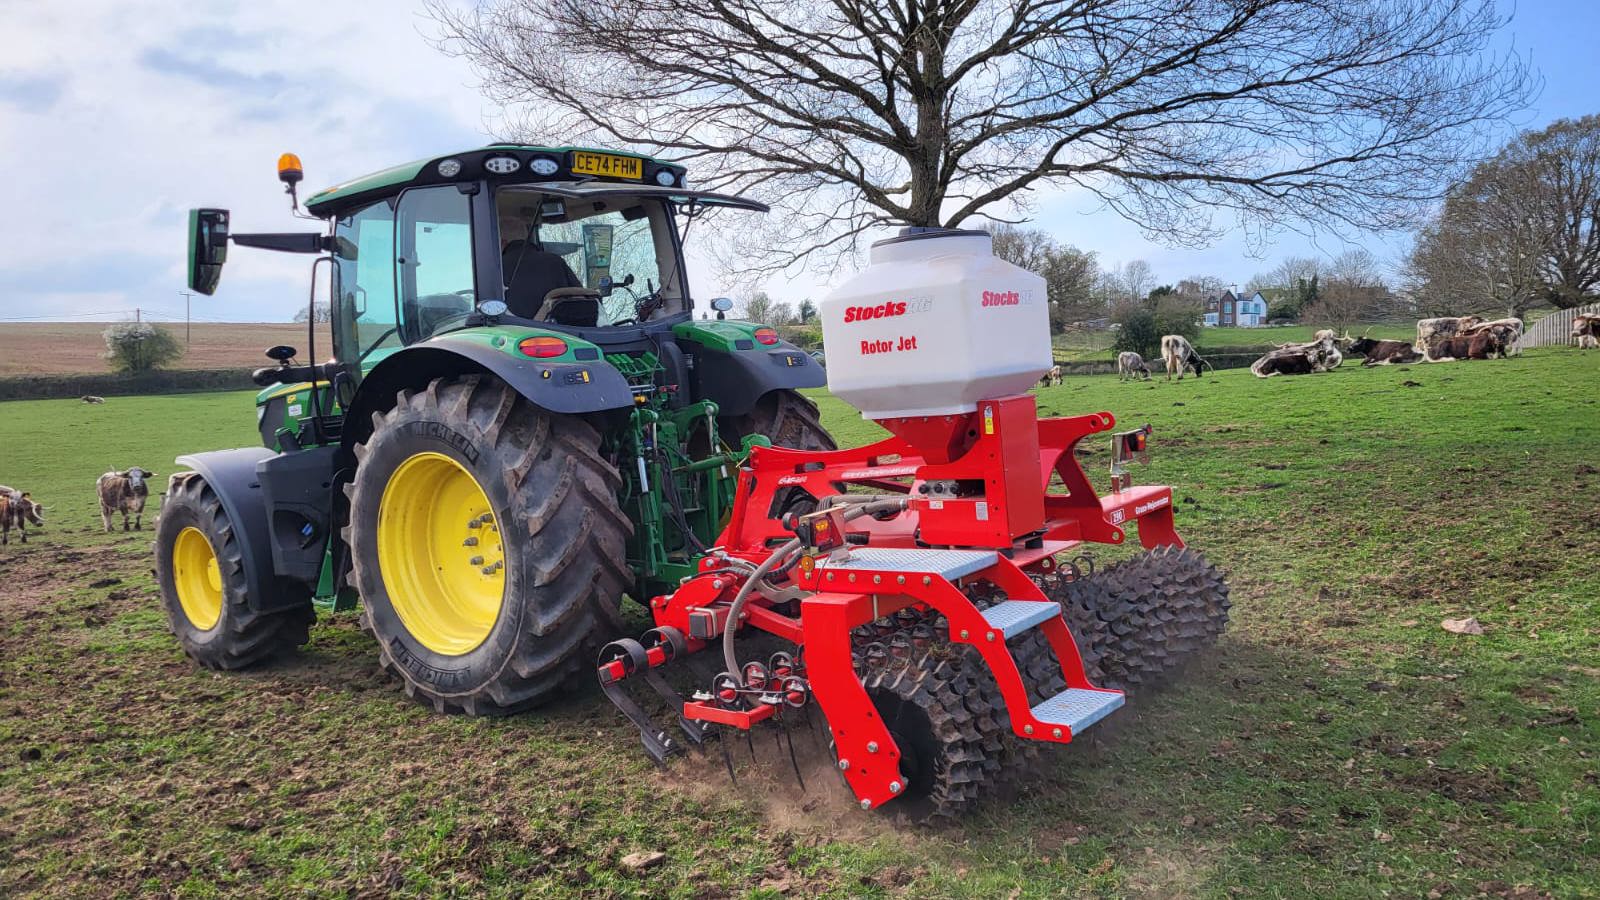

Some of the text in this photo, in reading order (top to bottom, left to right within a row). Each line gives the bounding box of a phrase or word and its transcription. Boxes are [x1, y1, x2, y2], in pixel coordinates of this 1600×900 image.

[577, 154, 638, 176] CE74 FHM
[981, 290, 1019, 307] Stocks
[844, 301, 907, 323] Stocks
[861, 335, 918, 355] Rotor Jet
